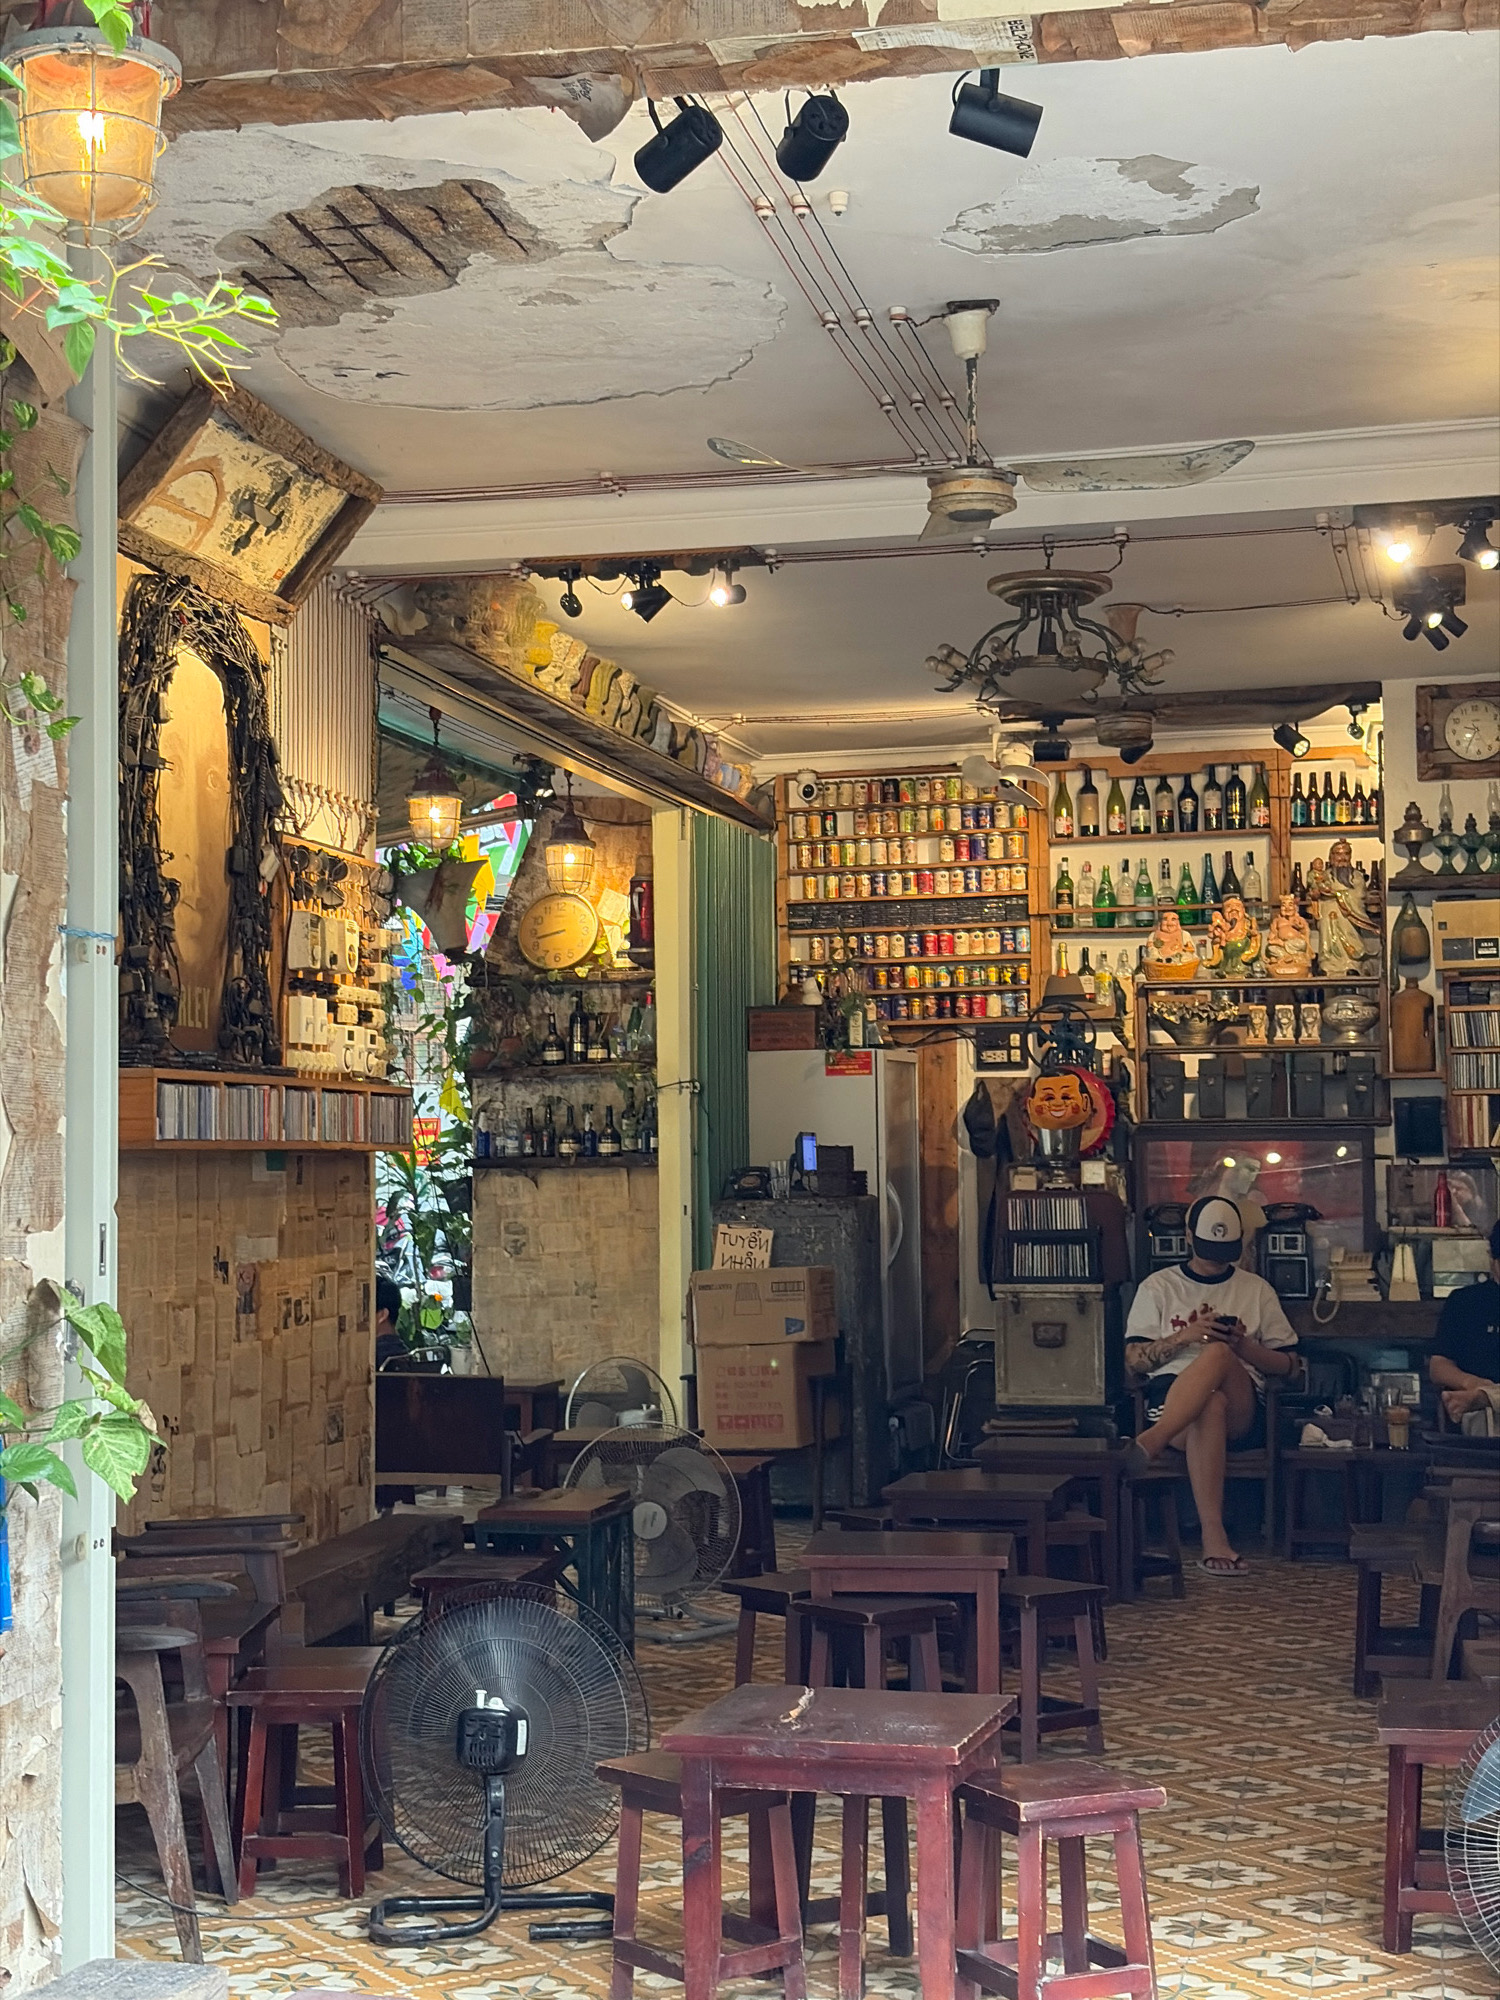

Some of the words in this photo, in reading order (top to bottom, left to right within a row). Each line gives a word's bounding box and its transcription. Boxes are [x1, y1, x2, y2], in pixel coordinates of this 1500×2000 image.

[544, 906, 552, 914] 11
[557, 902, 566, 911] 12
[573, 905, 576, 913] 1
[531, 916, 543, 925] 10
[579, 914, 586, 923] 2
[530, 928, 538, 936] 9
[582, 926, 589, 936] 3
[532, 941, 540, 950] 8
[554, 953, 561, 962] 6
[567, 949, 574, 958] 5
[720, 1230, 769, 1253] TUYỂN
